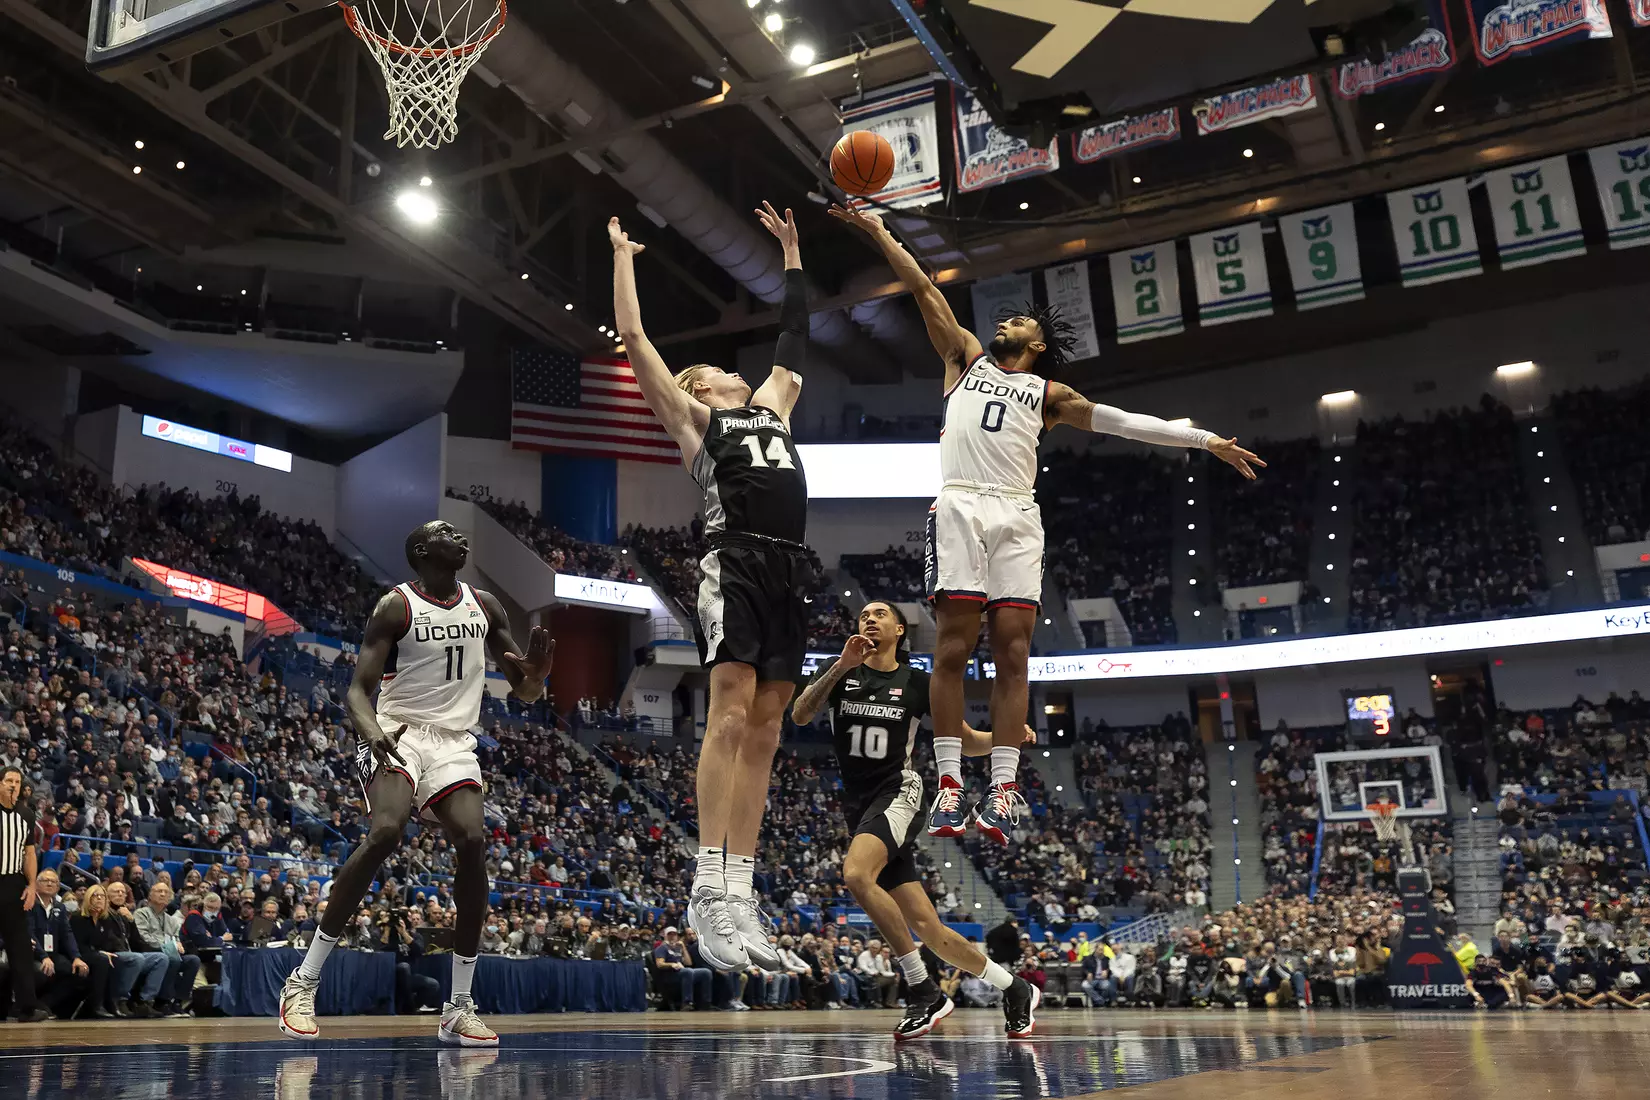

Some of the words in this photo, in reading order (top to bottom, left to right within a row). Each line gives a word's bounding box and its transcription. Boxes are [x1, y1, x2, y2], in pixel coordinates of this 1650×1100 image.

[1485, 19, 1535, 51] WOLF
[1510, 194, 1560, 237] 11
[1409, 214, 1461, 257] 10
[1308, 241, 1337, 280] 9
[1216, 259, 1246, 295] 5
[1134, 278, 1159, 316] 2
[964, 377, 1040, 411] UCONN
[720, 413, 787, 434] PROVIDENCE
[981, 401, 1007, 432] 0
[740, 434, 796, 470] 14
[470, 484, 490, 497] 231
[56, 568, 76, 583] 105
[580, 581, 628, 602] xfinity
[415, 623, 486, 642] UCONN
[444, 645, 464, 681] 11
[1028, 661, 1087, 677] eyBank
[643, 694, 660, 704] 107
[840, 700, 905, 720] PROVIDENCE
[1372, 710, 1390, 735] 3
[846, 724, 889, 760] 10
[1388, 984, 1469, 998] TRAVELERS
